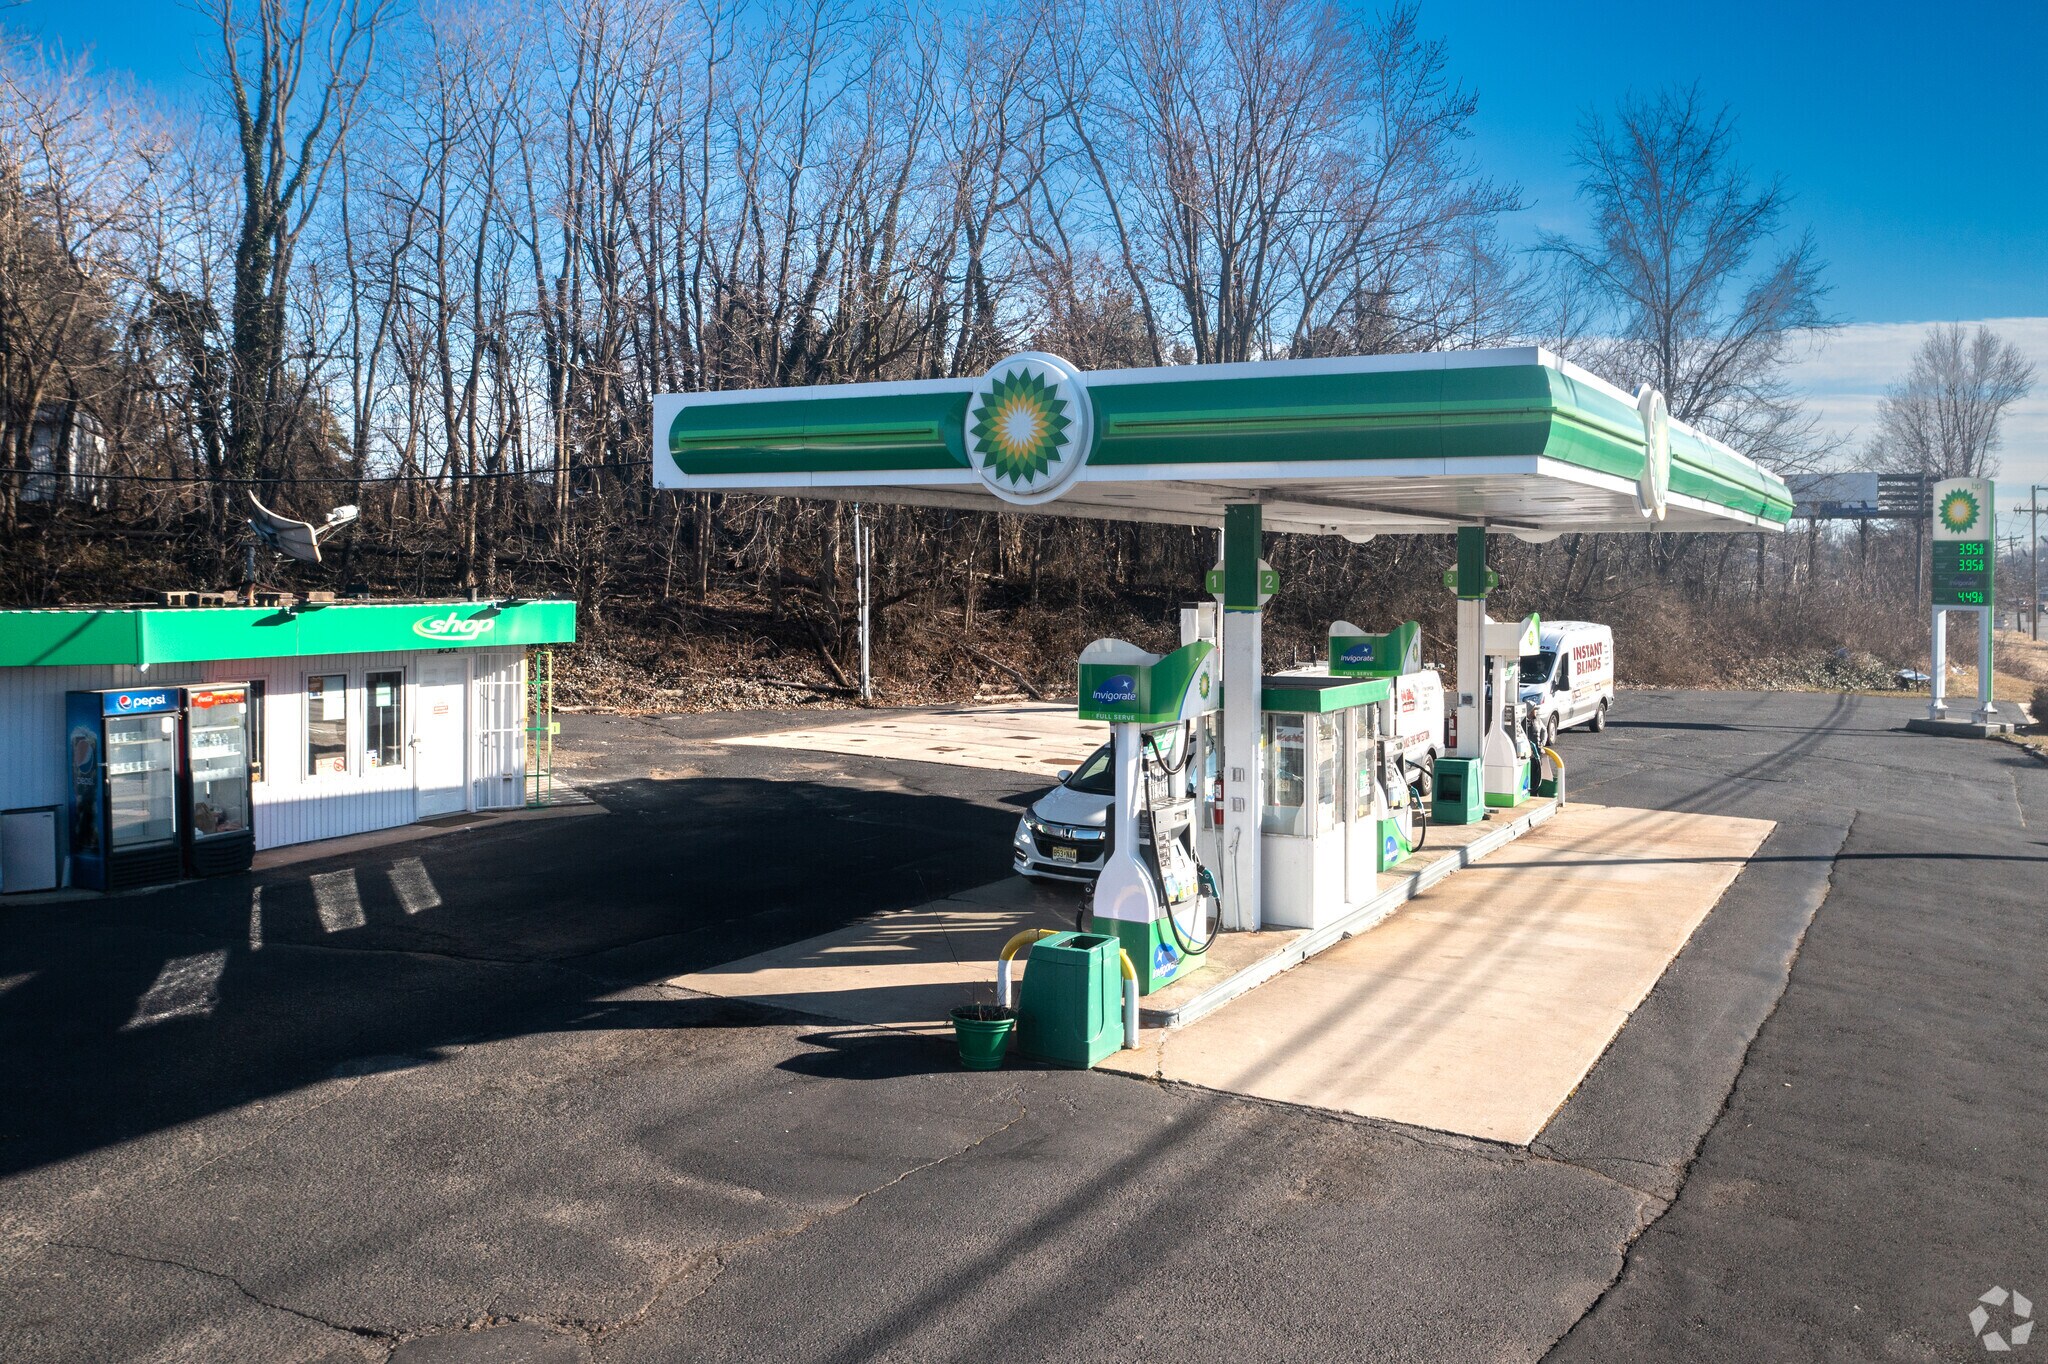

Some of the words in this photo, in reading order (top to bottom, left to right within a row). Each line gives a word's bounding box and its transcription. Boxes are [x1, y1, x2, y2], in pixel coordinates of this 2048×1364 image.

[1971, 482, 1982, 490] bp
[1211, 575, 1217, 588] 1
[1264, 575, 1273, 589] 2
[1447, 573, 1453, 583] 3
[1487, 574, 1494, 584] 4
[429, 612, 495, 640] shop
[1573, 642, 1603, 660] INSTANT
[1341, 654, 1374, 663] Invigorate
[1576, 657, 1602, 675] BLINDS
[133, 694, 166, 708] pepsi
[1092, 690, 1136, 701] Invigorate
